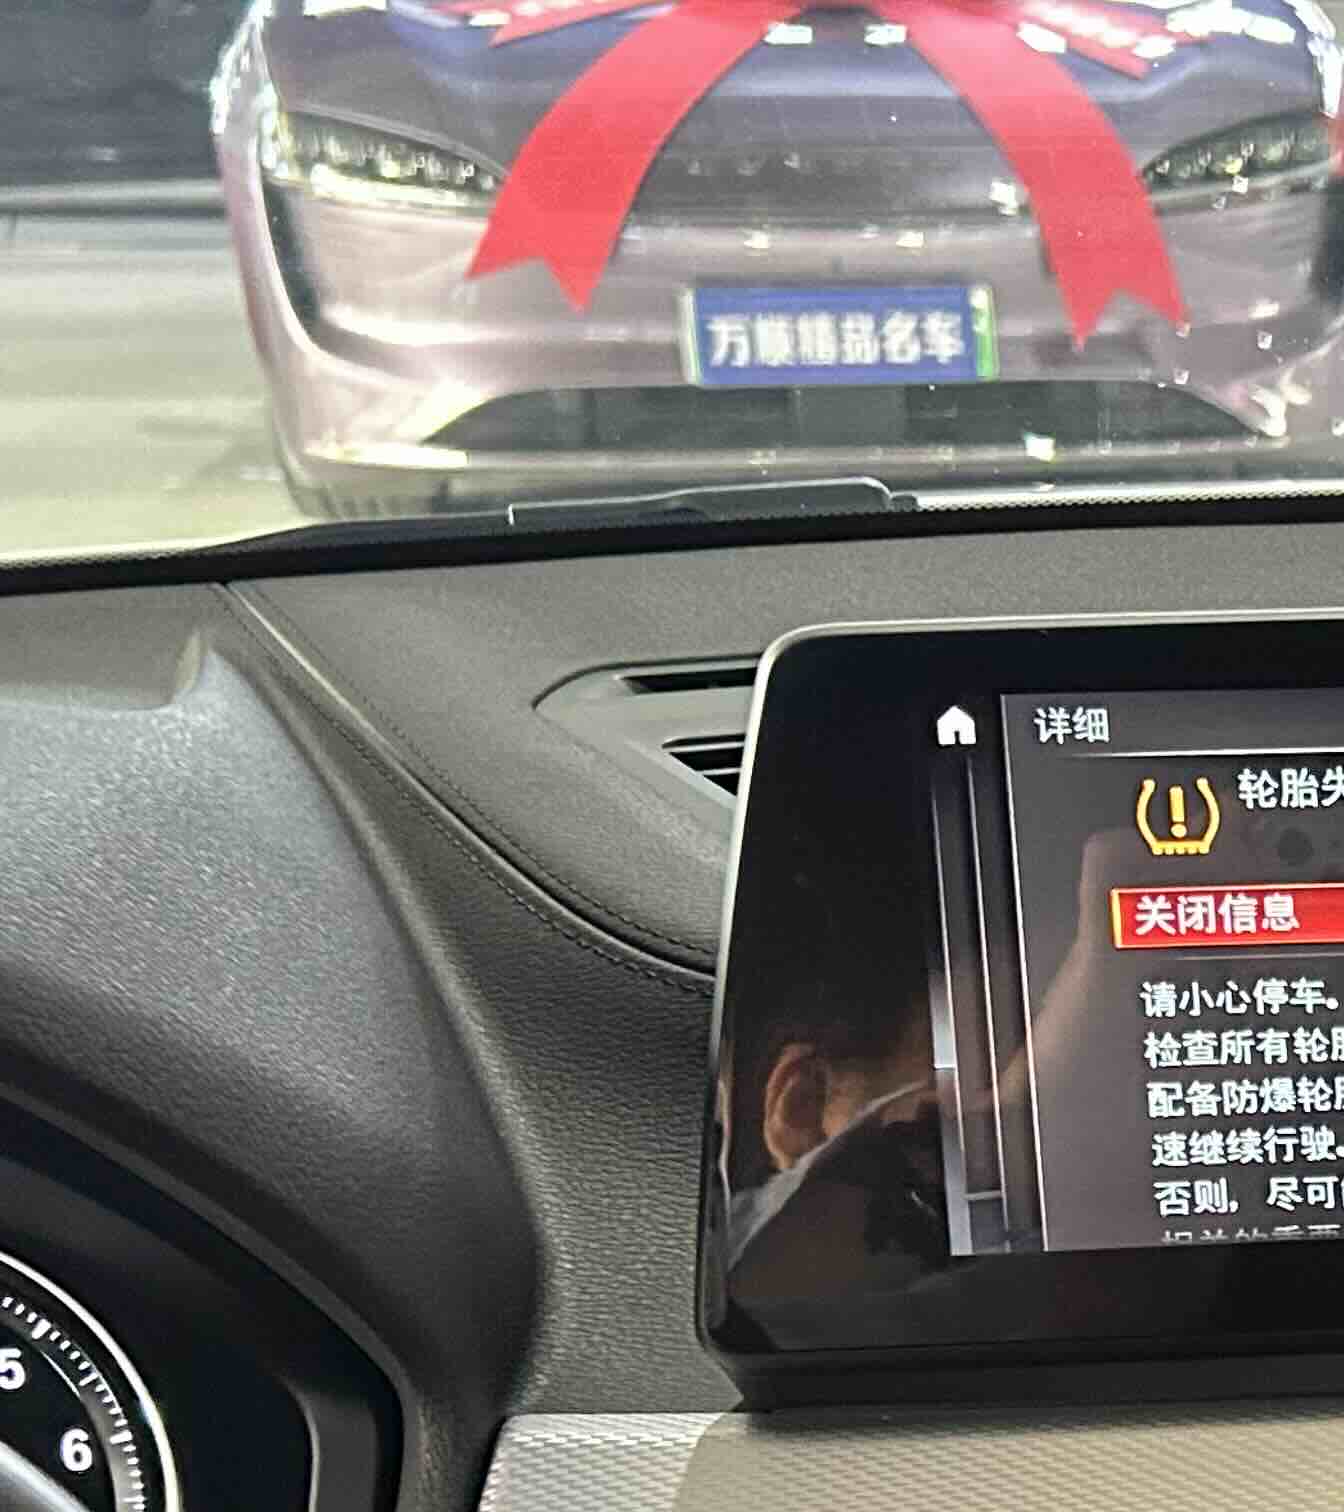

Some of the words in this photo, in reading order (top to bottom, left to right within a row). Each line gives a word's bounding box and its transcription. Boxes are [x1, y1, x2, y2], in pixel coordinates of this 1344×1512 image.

[1033, 705, 1111, 745] 详细
[1134, 893, 1300, 935] 关闭信息
[1139, 976, 1339, 1018] 请小心停车。
[60, 1428, 93, 1472] 6
